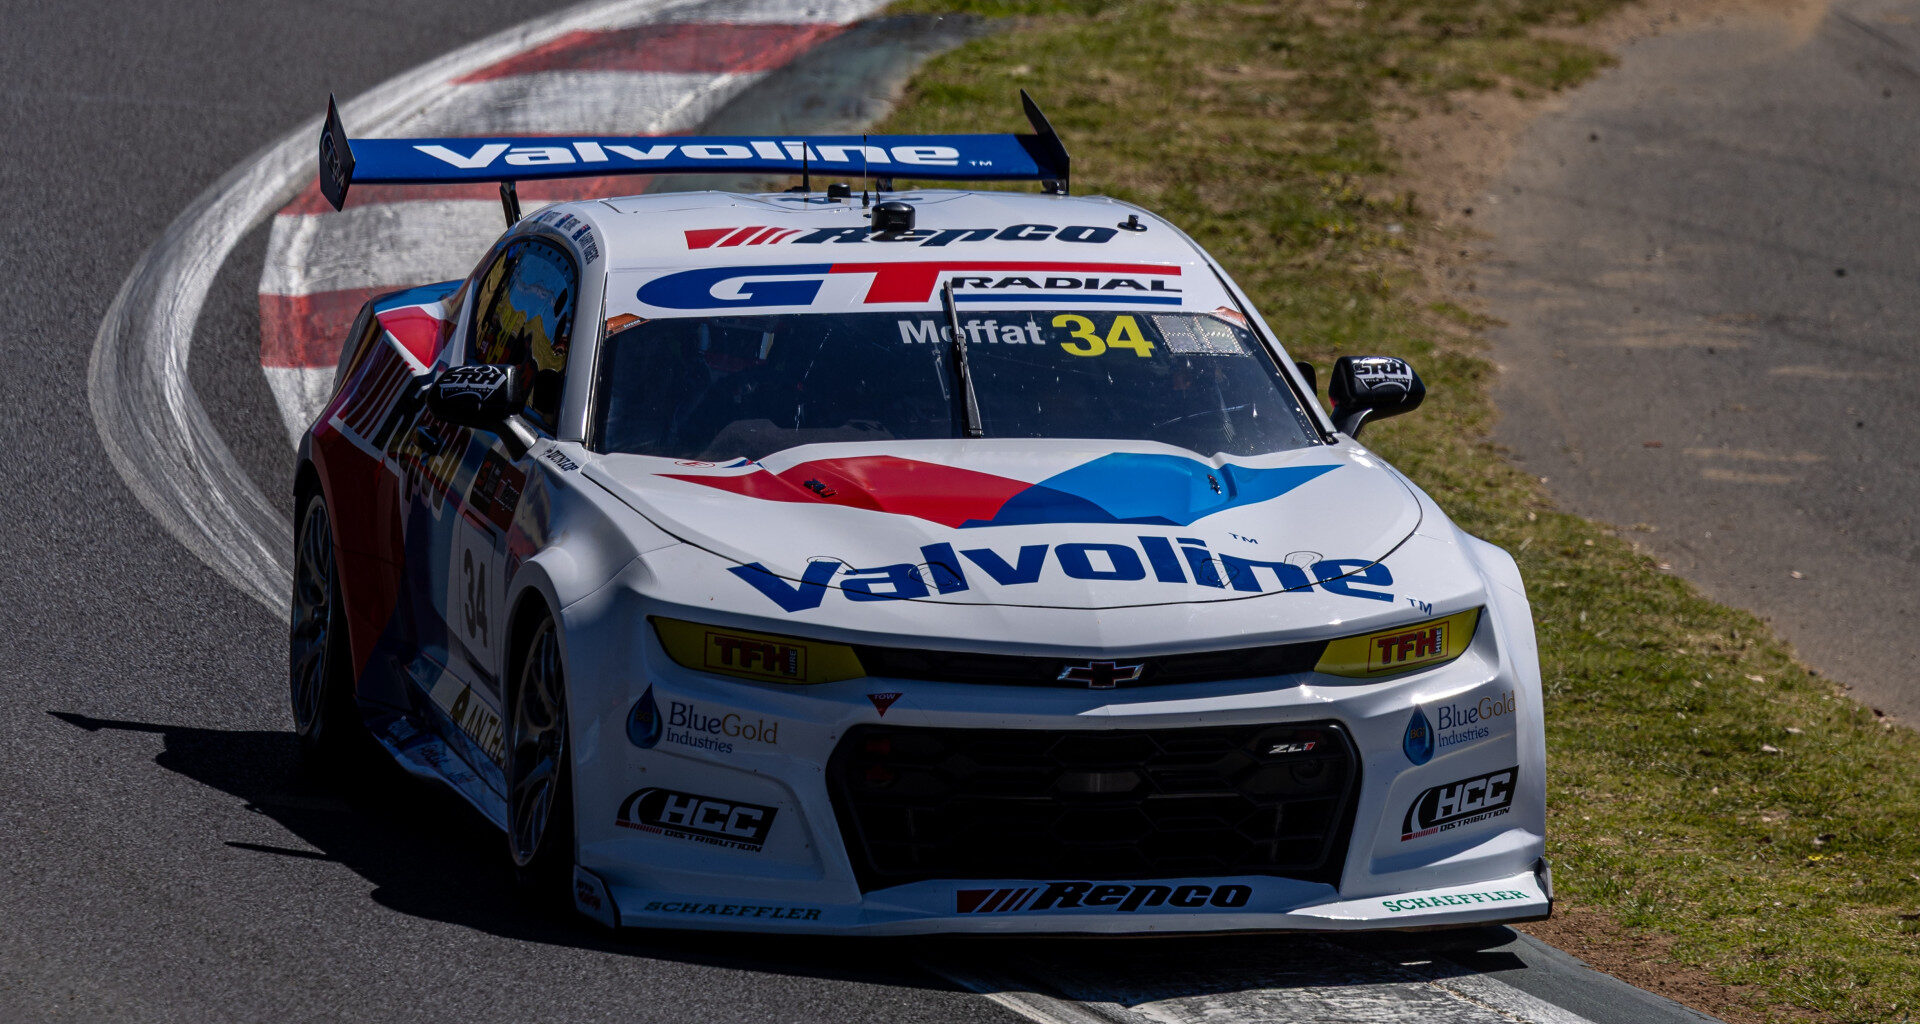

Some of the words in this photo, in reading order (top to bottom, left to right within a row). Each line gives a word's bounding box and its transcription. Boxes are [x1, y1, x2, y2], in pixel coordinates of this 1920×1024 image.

[412, 141, 960, 169] Valvoline
[792, 223, 1119, 247] Repco
[636, 261, 941, 310] GT
[951, 276, 1183, 293] RADIAL
[898, 320, 1046, 346] Moffat
[1051, 314, 1155, 358] 34
[1355, 362, 1411, 377] SRH
[546, 449, 580, 472] DUNLOP
[728, 535, 1396, 613] Valvoline
[463, 547, 489, 648] 34
[714, 637, 791, 676] TFH
[1377, 628, 1437, 665] TFH
[669, 701, 779, 745] BlueGold
[1438, 690, 1516, 731] BlueGold
[666, 727, 733, 754] Industries
[1268, 741, 1317, 754] ZL1
[1438, 726, 1490, 748] Industries
[1435, 771, 1511, 820] HCC
[659, 792, 764, 838] HCC
[1439, 806, 1511, 832] DISTRIBUTION
[664, 830, 763, 852] DISTRIBUTION
[644, 901, 822, 921] SCHAEFFLER
[1028, 881, 1253, 912] Repco
[1382, 889, 1530, 913] SCHAEFFLER
